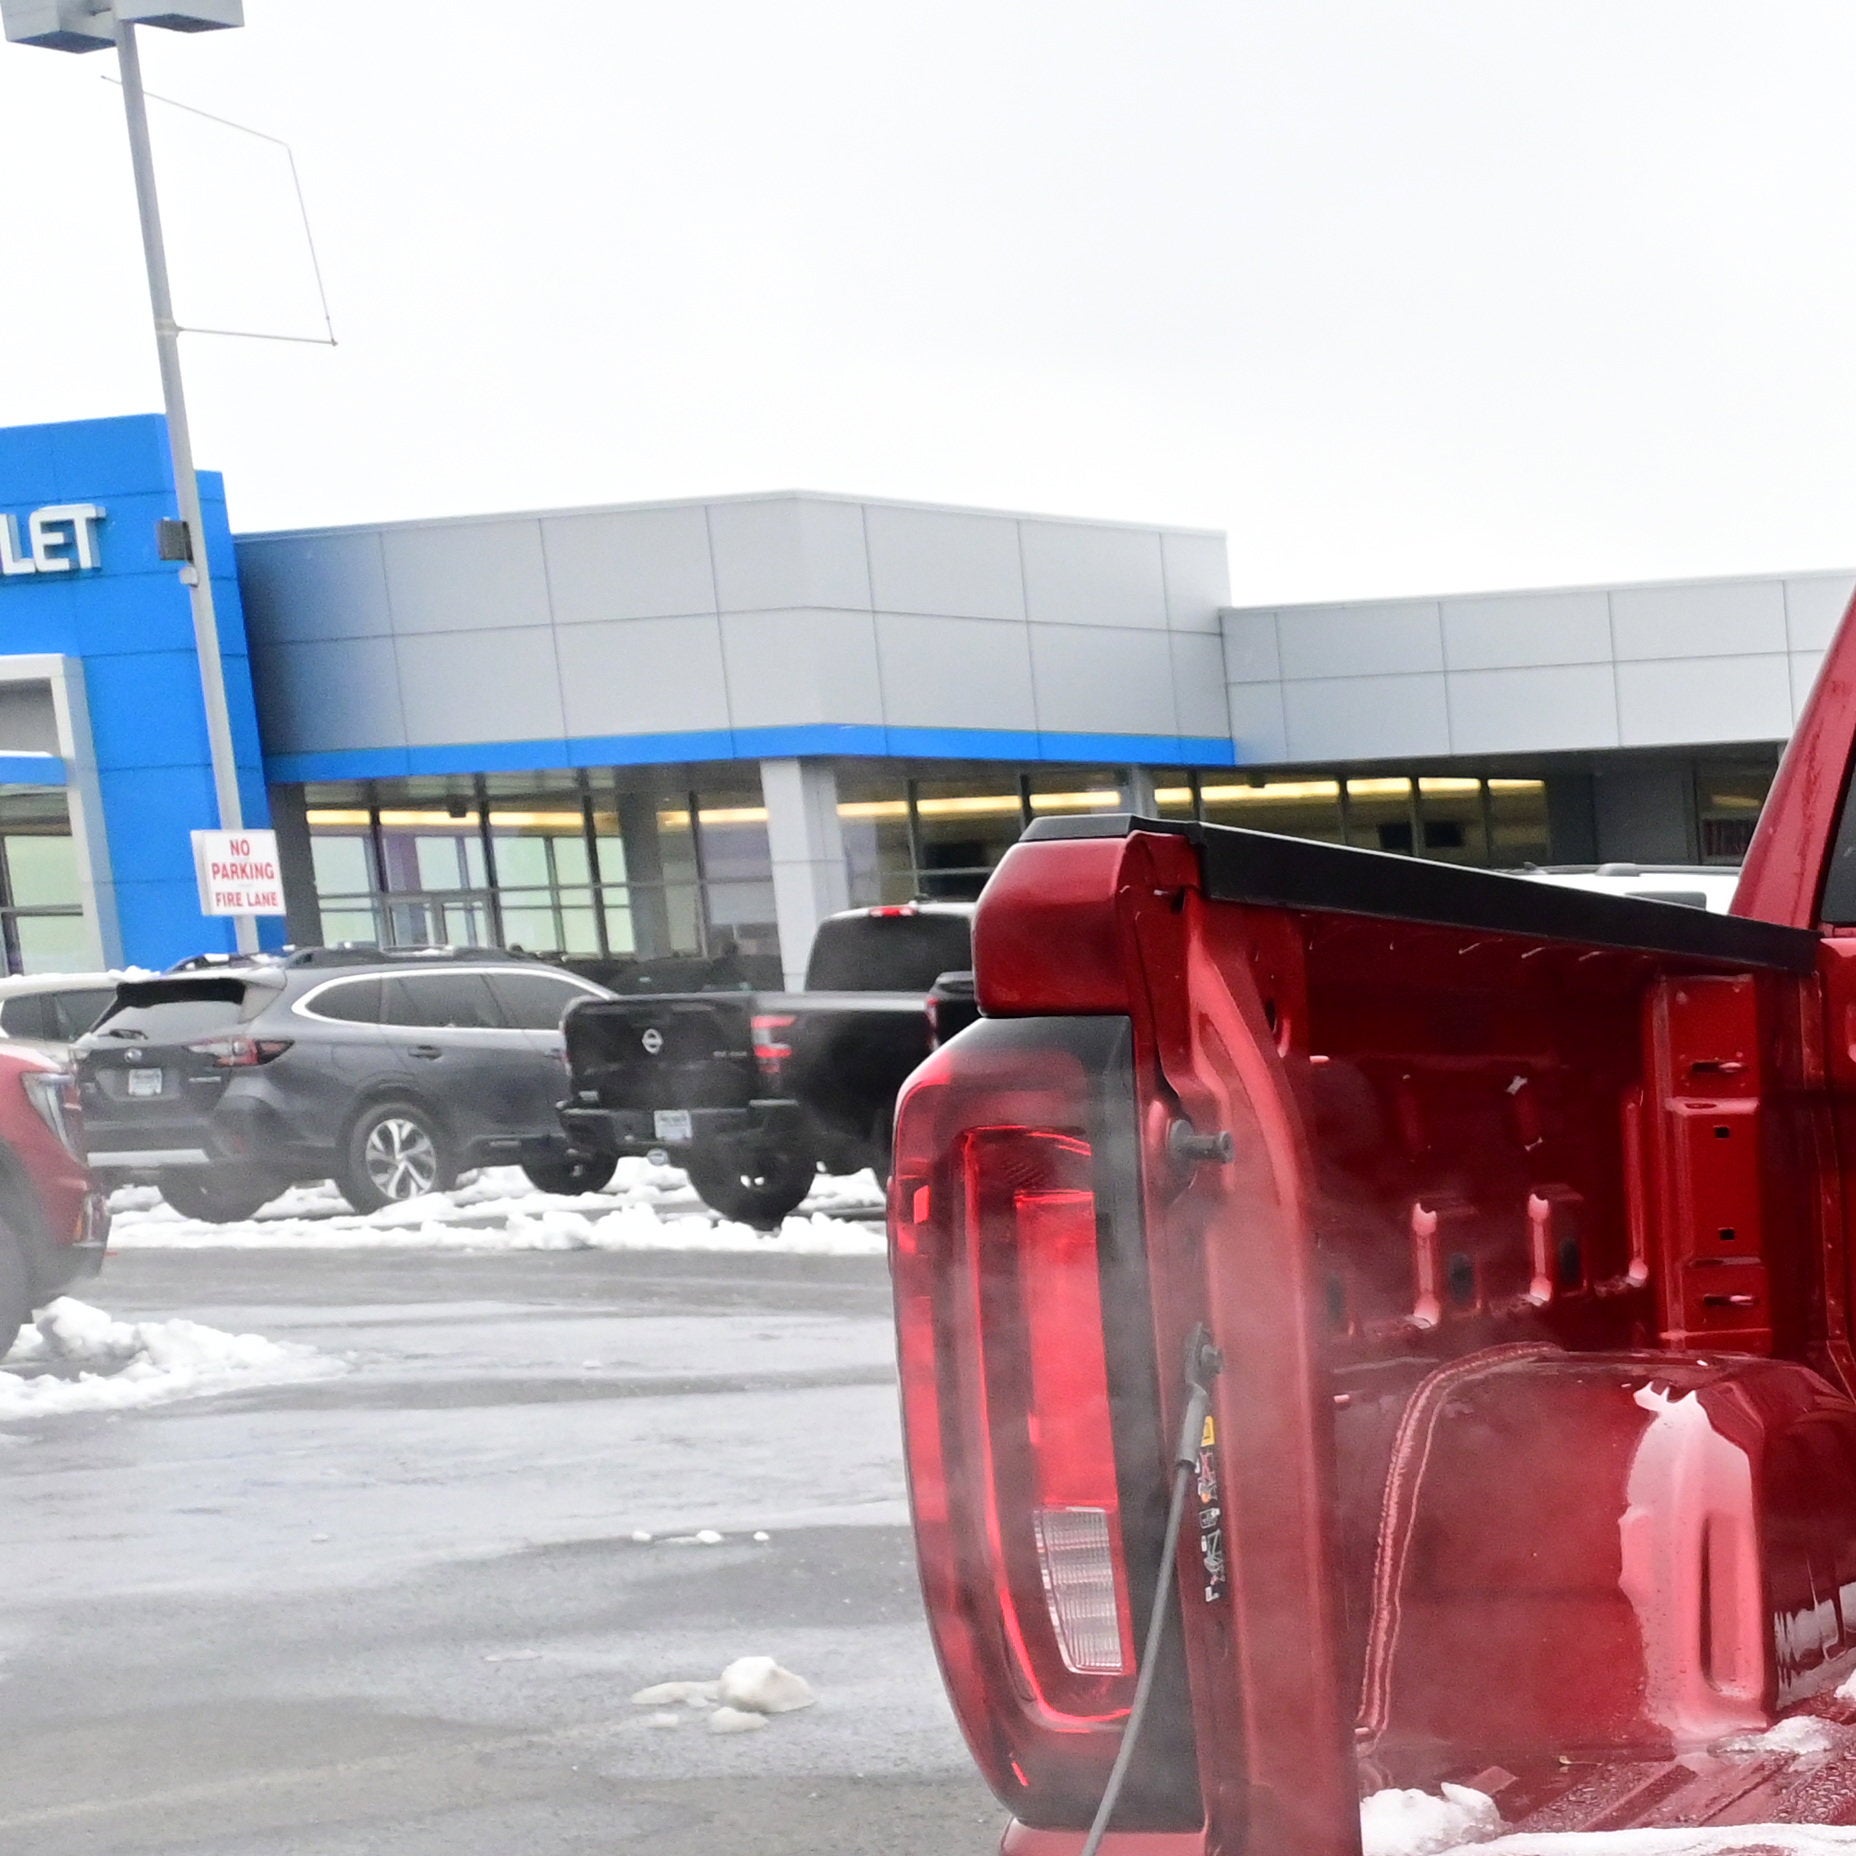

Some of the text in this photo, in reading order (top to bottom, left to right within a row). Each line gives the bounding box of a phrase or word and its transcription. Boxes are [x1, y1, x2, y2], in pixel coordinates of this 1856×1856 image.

[229, 839, 250, 857] NO
[211, 862, 275, 880] PARKING
[215, 892, 279, 907] FIRE LANE
